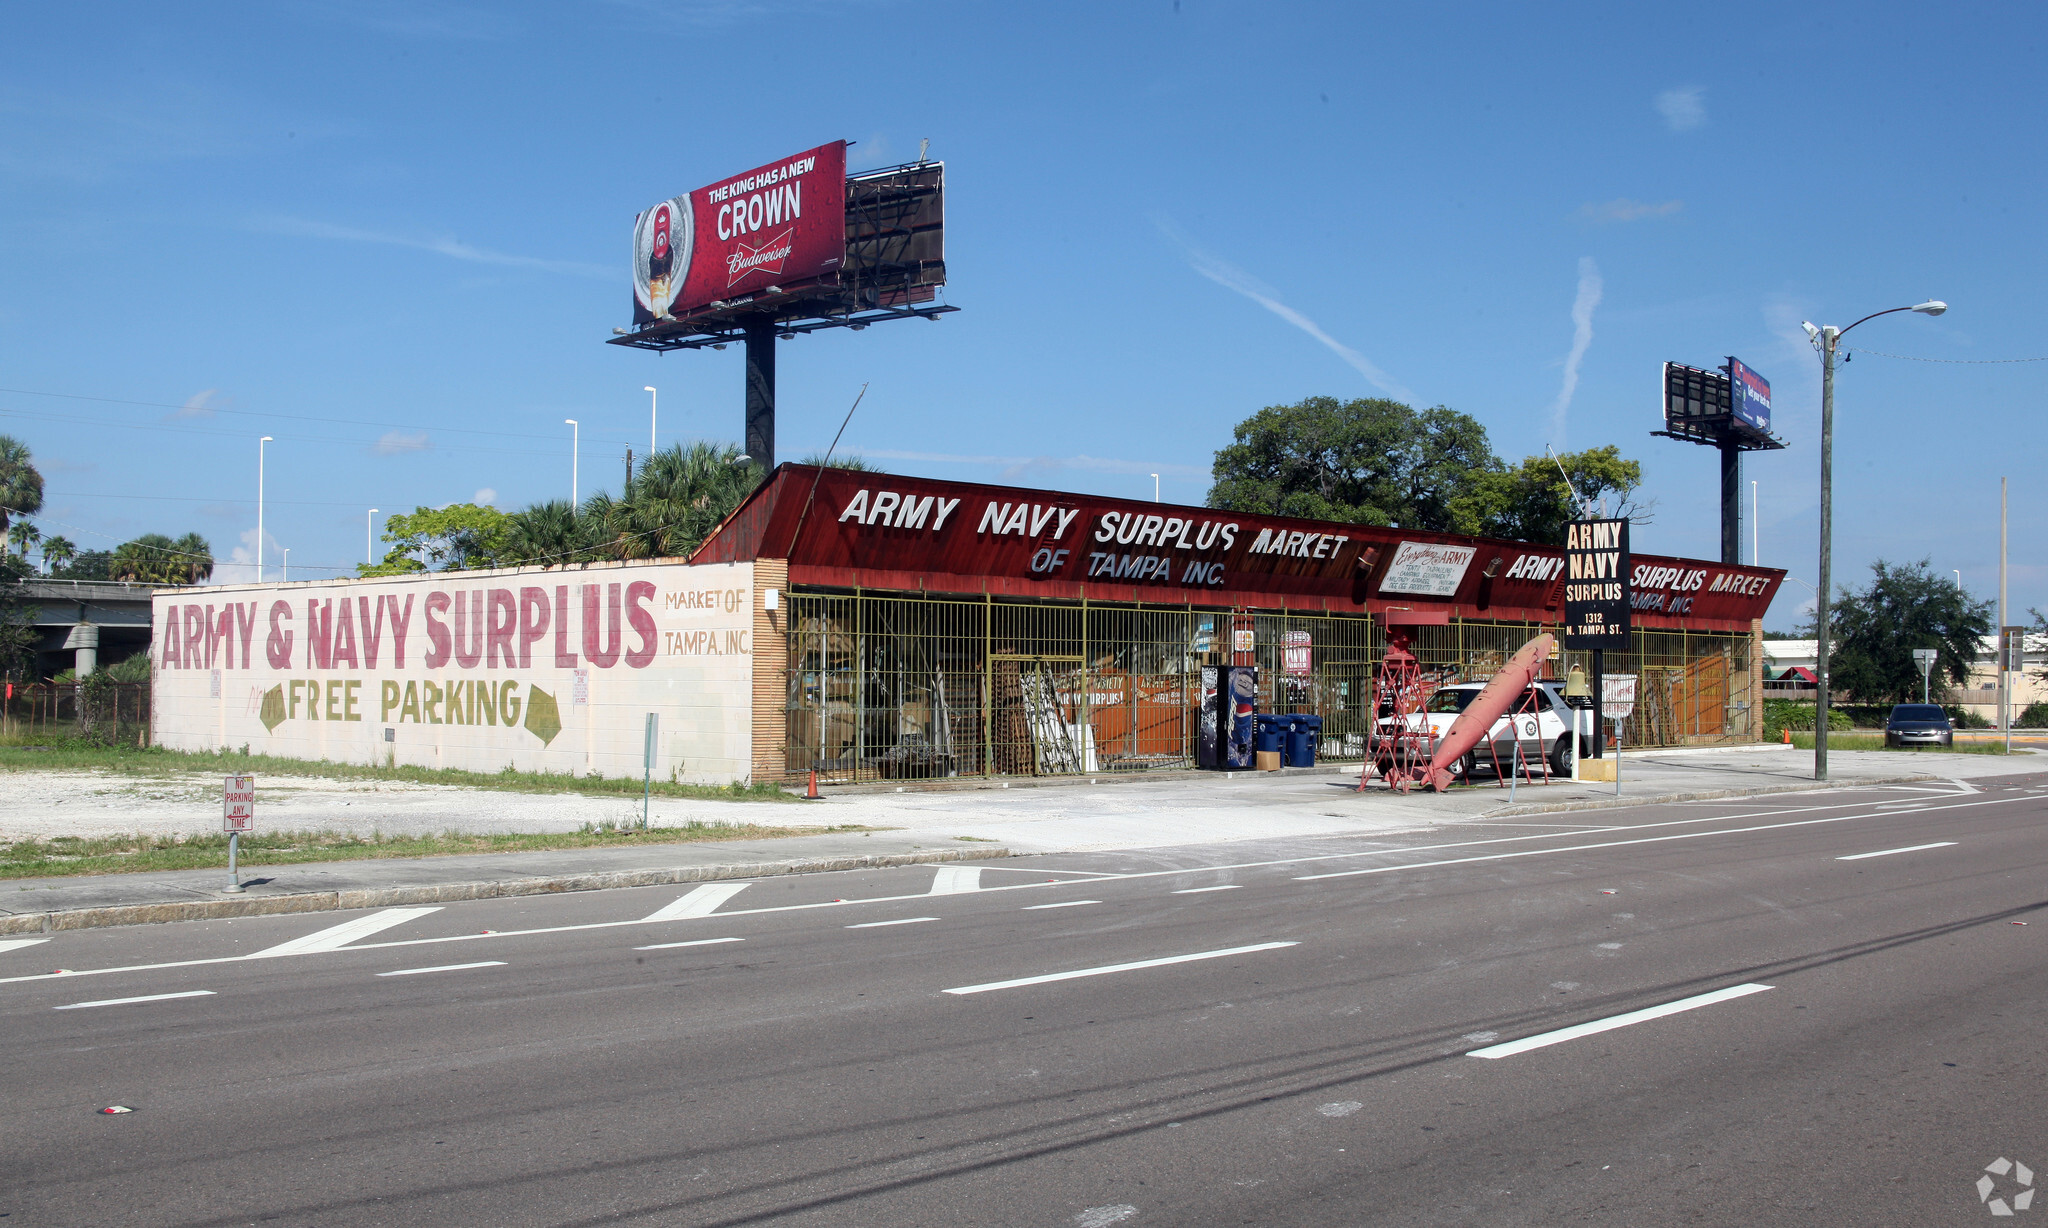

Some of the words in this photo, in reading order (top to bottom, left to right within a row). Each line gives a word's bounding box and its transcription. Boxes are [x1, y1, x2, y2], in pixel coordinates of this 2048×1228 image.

[708, 186, 729, 205] THE
[729, 176, 754, 198] KING
[756, 169, 779, 189] HAS
[779, 166, 788, 182] A
[789, 156, 816, 178] NEW
[718, 180, 801, 241] CROWN
[726, 245, 792, 275] Budweiser
[838, 489, 961, 531] ARMY
[977, 501, 1080, 540] NAVY
[1095, 511, 1239, 551] SURPLUS
[1249, 527, 1349, 559] MARKET
[1567, 522, 1622, 550] ARMY
[1030, 548, 1070, 573] OF
[1087, 552, 1171, 581] TAMPA
[1181, 560, 1225, 584] INC.
[1440, 550, 1472, 566] ARMY
[1506, 555, 1565, 581] ARMY
[1569, 552, 1620, 579] NAVY
[1566, 582, 1622, 602] SURPLUS
[1630, 564, 1707, 591] SURPLUS
[1708, 573, 1772, 596] MARKET
[665, 590, 723, 610] MARKET
[725, 589, 746, 613] OF
[1630, 591, 1666, 613] AMPA
[161, 601, 258, 670] ARMY
[266, 600, 293, 670] &
[307, 593, 415, 670] NAVY
[424, 580, 658, 669] SURPLUS
[1566, 625, 1575, 636] N.
[1578, 624, 1606, 635] TAMPA
[1609, 623, 1623, 635] ST.
[1585, 612, 1603, 624] 1312
[665, 631, 723, 657] TAMPA,
[726, 630, 752, 655] INC.
[289, 679, 362, 722] FREE
[381, 679, 522, 727] PARKING
[226, 792, 253, 803] PARKING
[235, 779, 245, 790] NO
[232, 805, 245, 815] ANY
[231, 819, 245, 828] TIME
